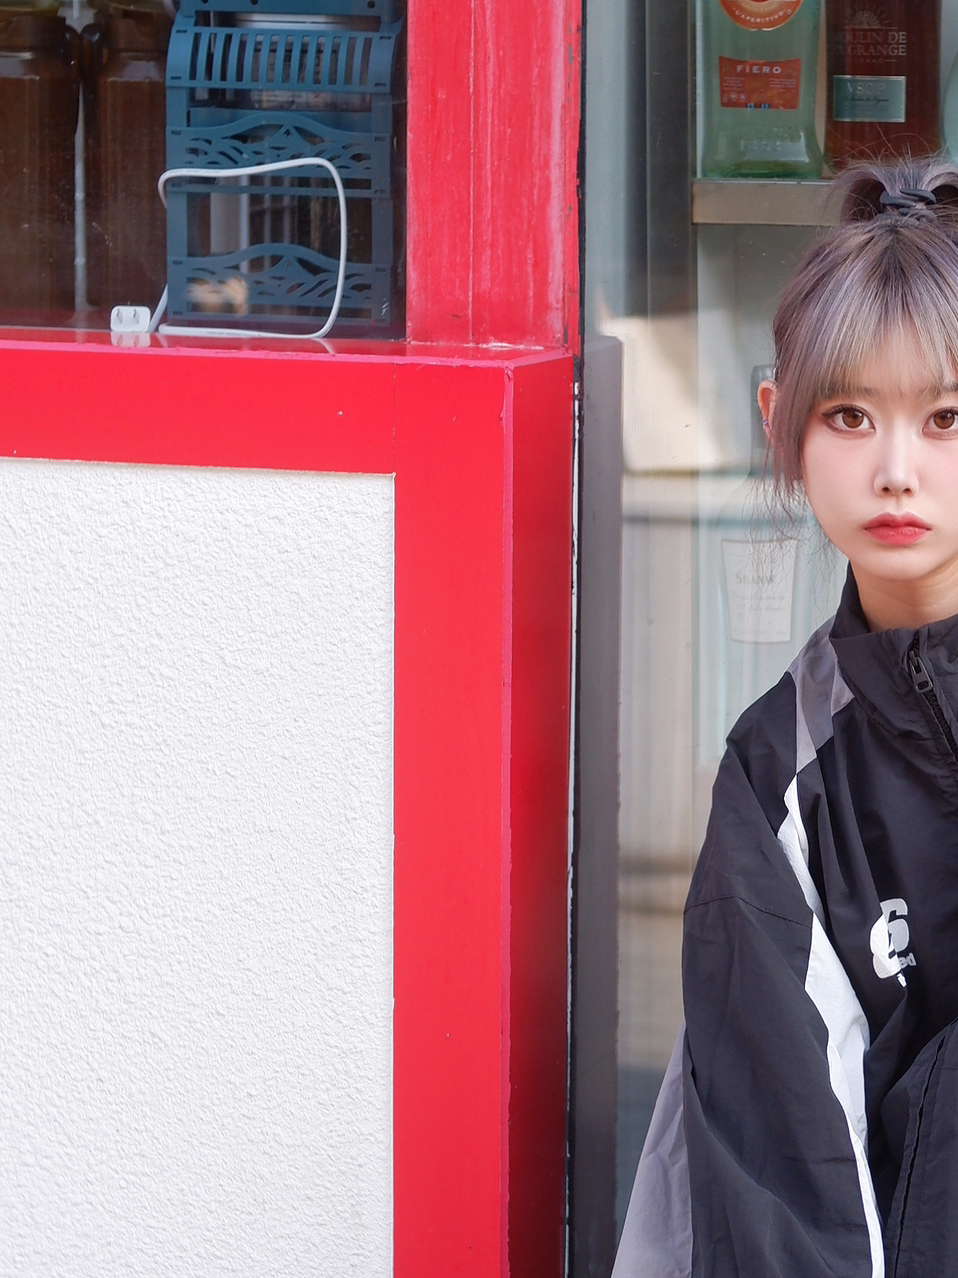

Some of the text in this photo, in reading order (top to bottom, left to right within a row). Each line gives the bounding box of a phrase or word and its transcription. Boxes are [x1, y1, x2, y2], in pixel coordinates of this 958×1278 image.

[887, 32, 907, 43] DE
[847, 45, 907, 56] GRANGE
[736, 65, 782, 74] FIERO
[846, 82, 887, 94] VSOP
